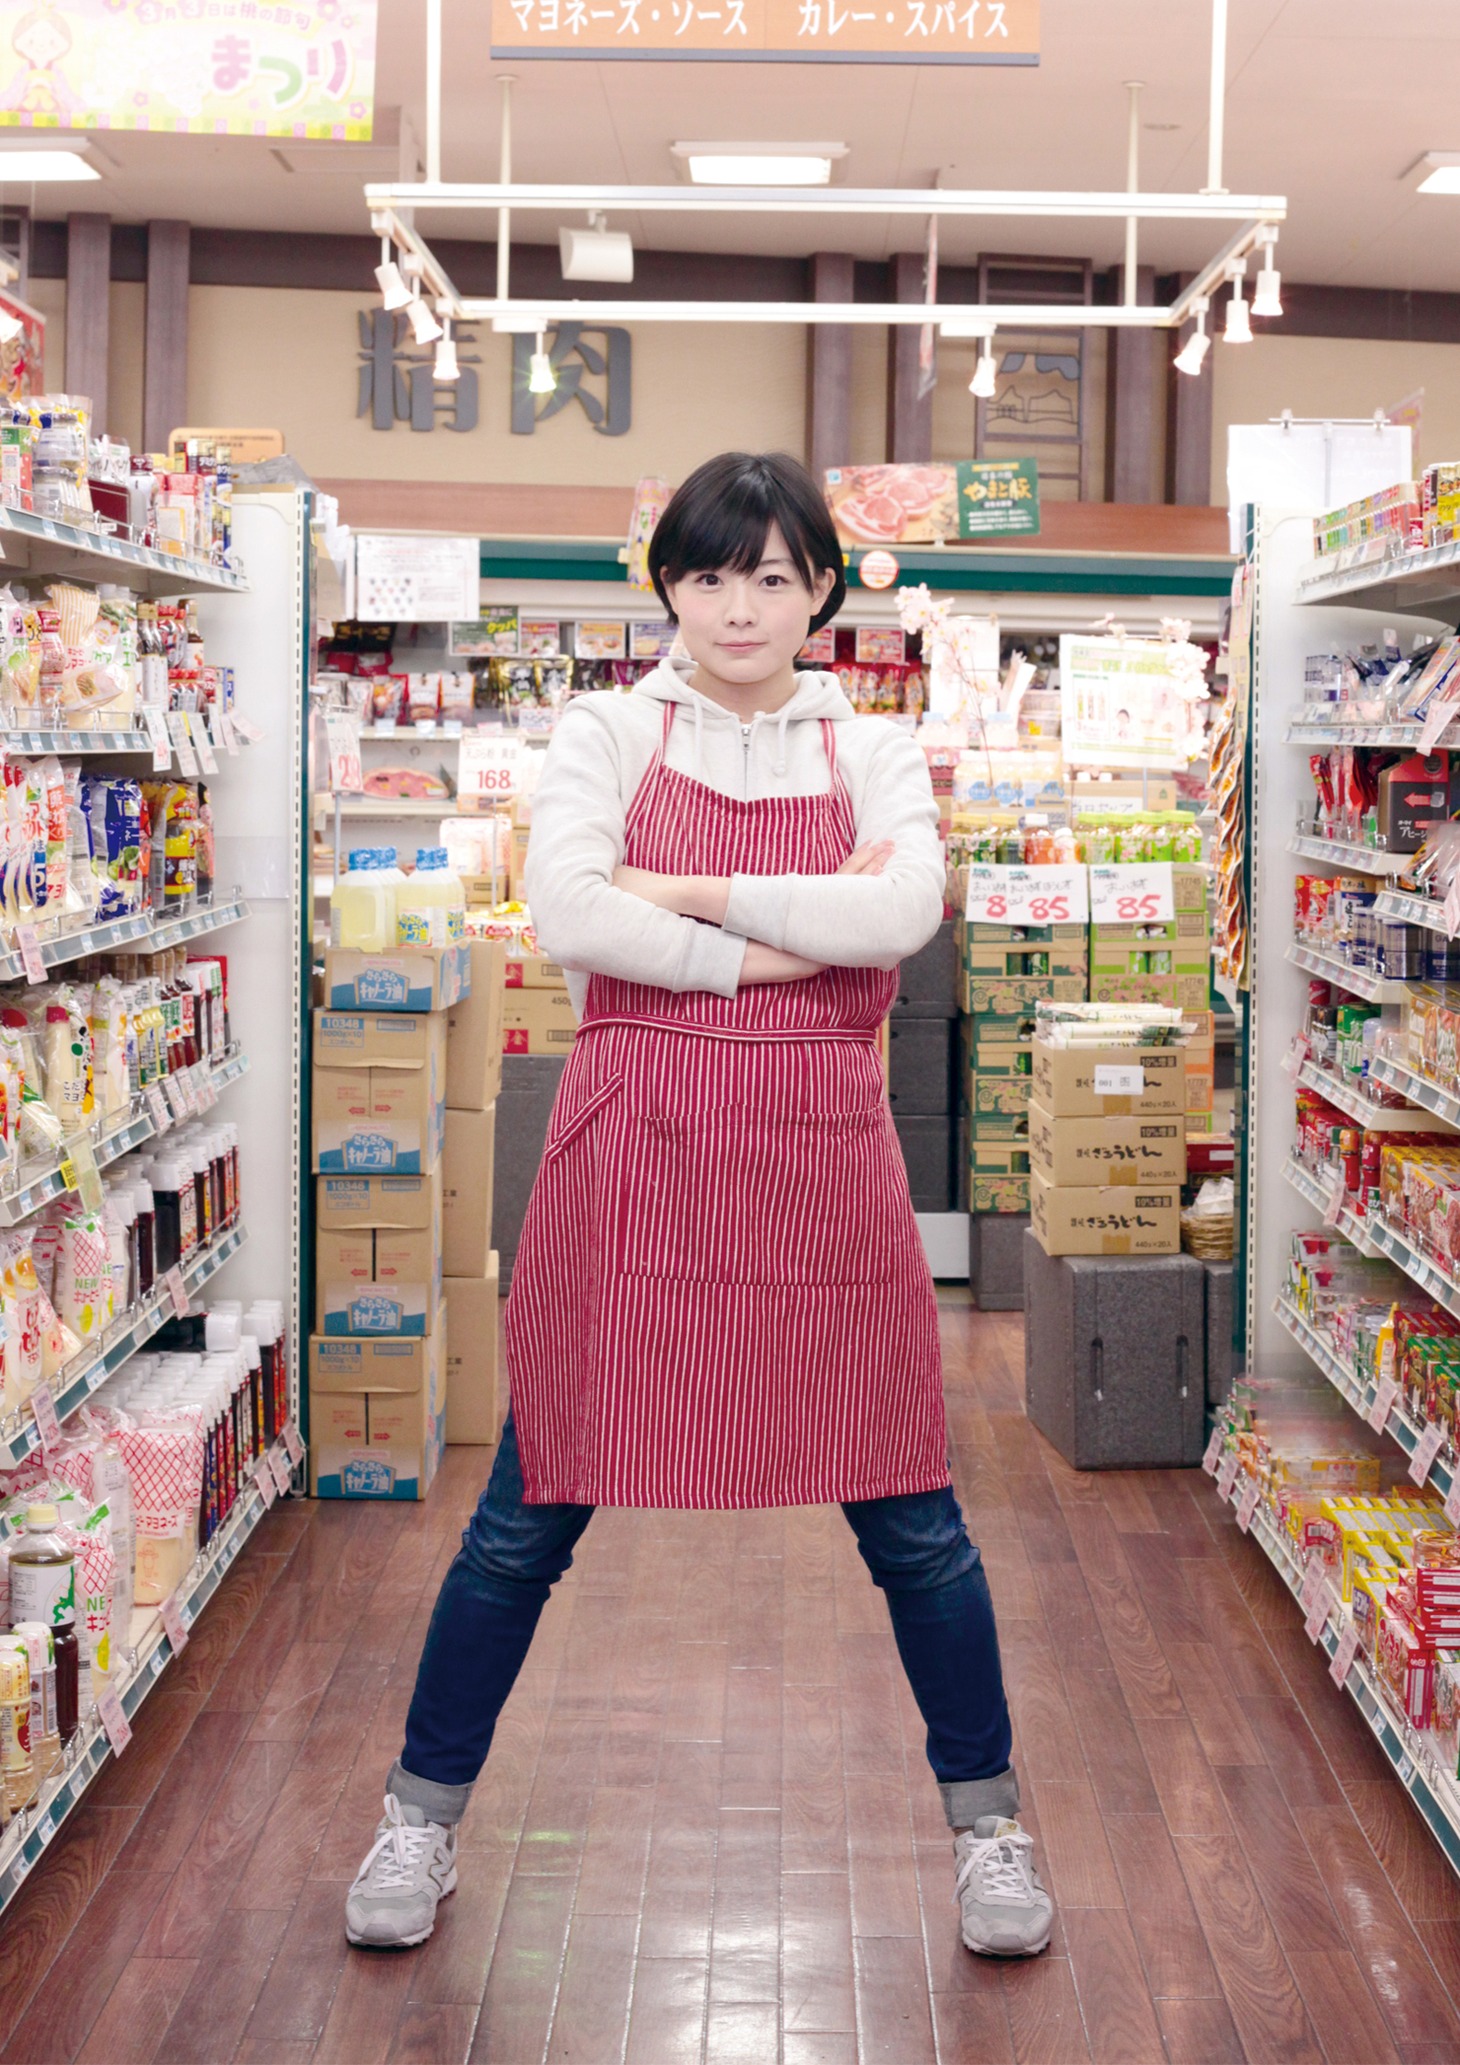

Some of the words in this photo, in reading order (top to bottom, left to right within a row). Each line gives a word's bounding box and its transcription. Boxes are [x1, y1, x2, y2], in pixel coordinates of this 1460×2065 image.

[511, 0, 747, 36] マヨネーズ・ソース
[798, 0, 1009, 38] カレー・スパイス
[358, 305, 632, 436] 精肉
[477, 769, 512, 790] 168
[1028, 896, 1071, 920] 85
[1115, 895, 1162, 919] 85
[74, 1278, 99, 1289] NEW
